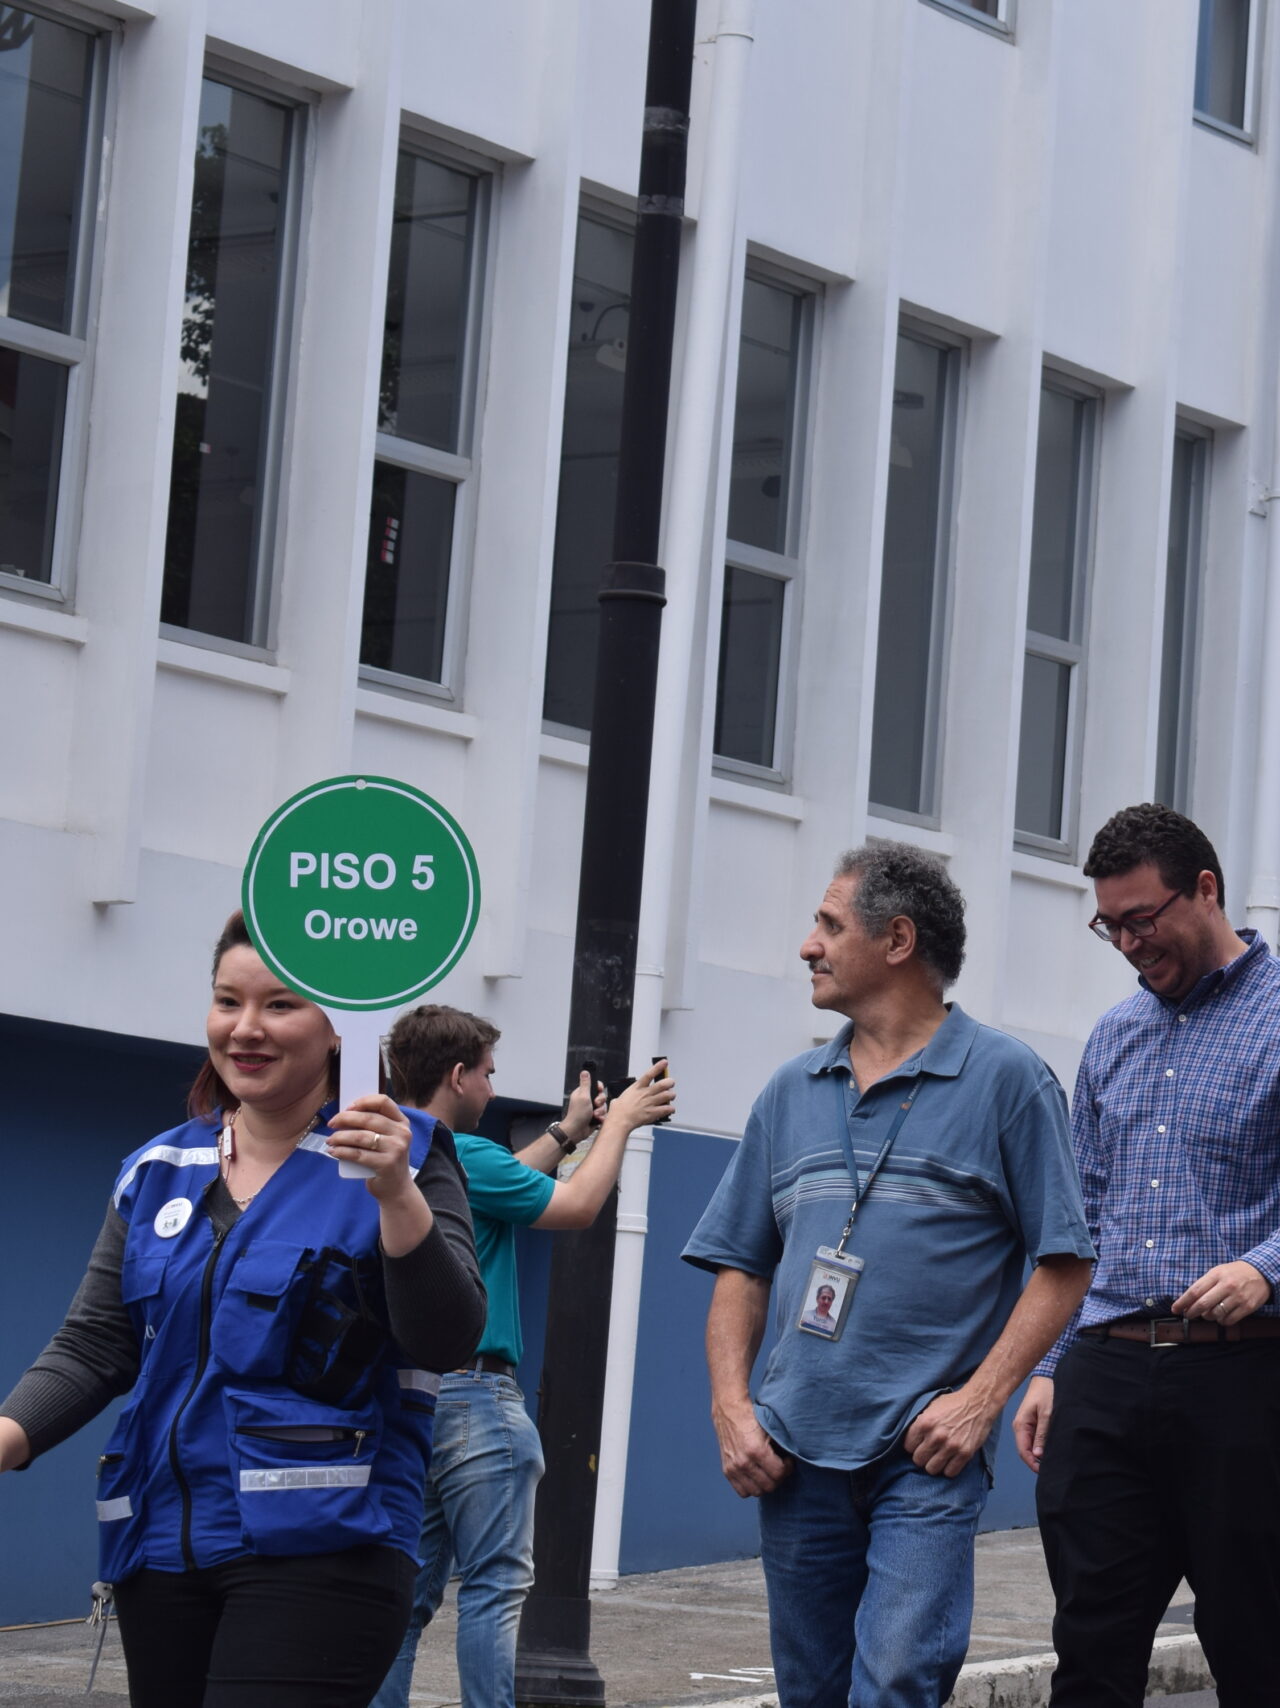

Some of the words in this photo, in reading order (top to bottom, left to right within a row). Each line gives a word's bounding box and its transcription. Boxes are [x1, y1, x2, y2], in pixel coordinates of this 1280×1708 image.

[289, 851, 397, 890] PISO
[411, 854, 436, 891] 5
[304, 909, 418, 941] Orowe
